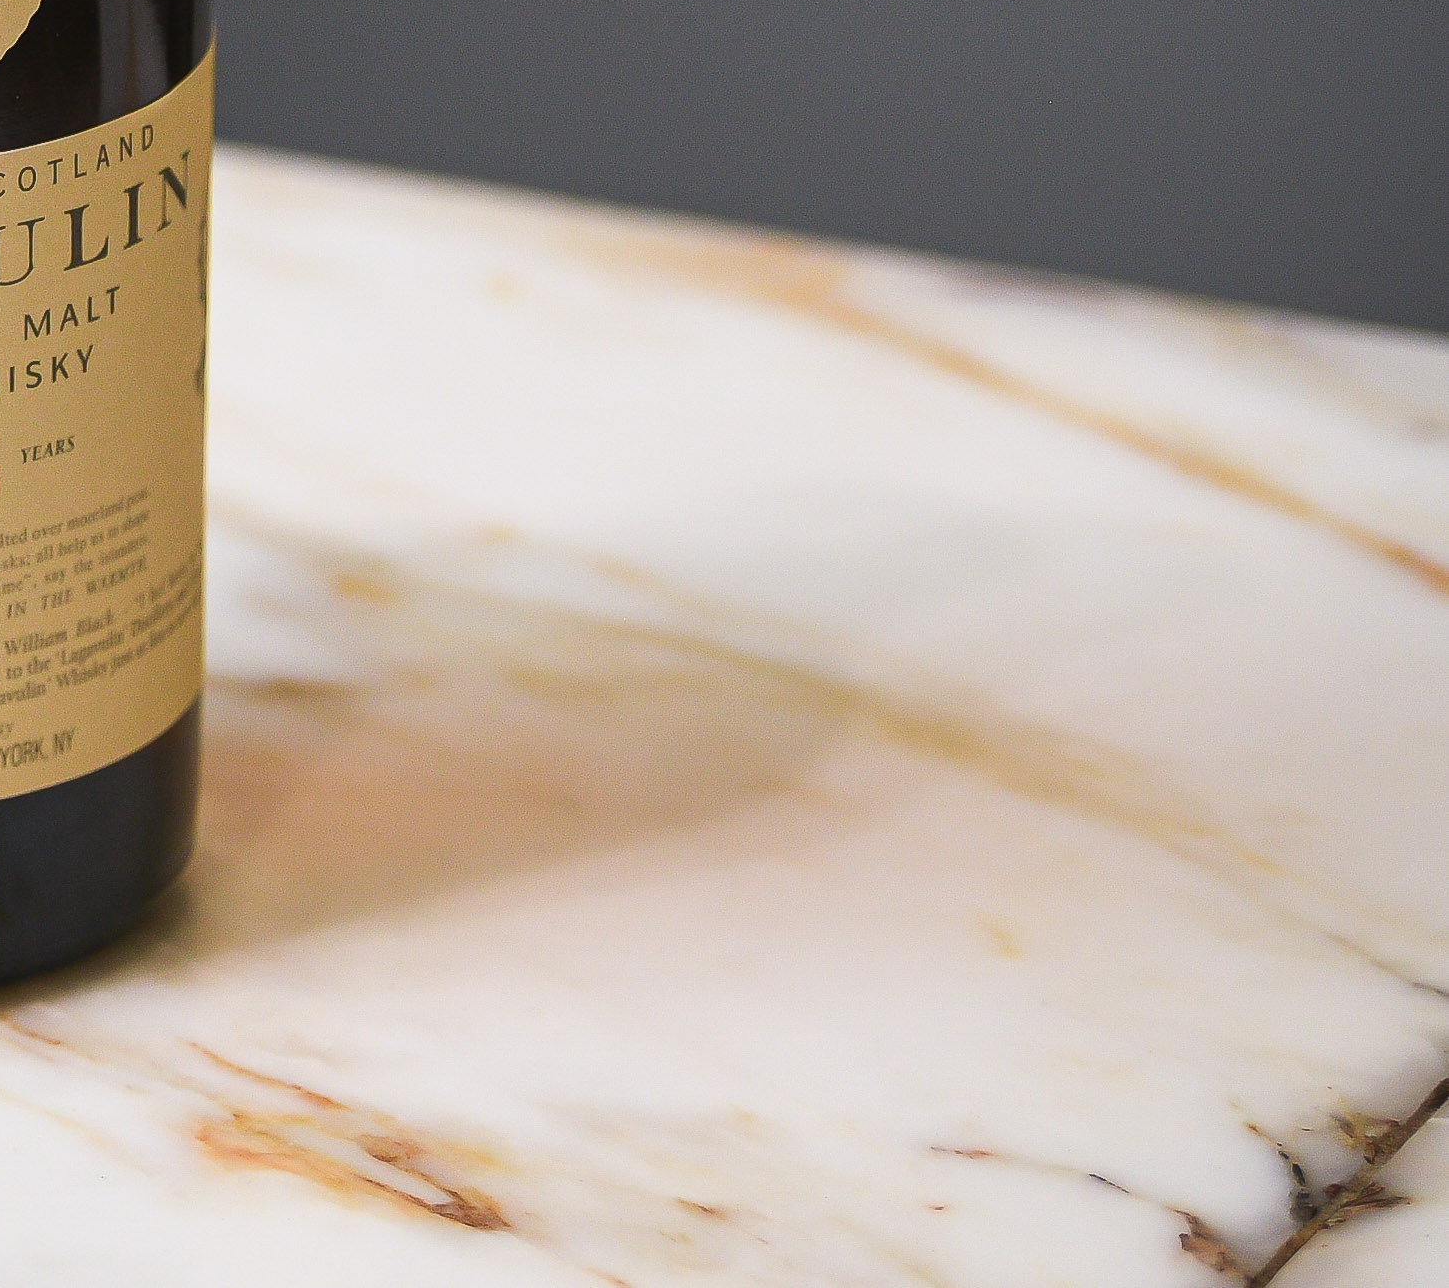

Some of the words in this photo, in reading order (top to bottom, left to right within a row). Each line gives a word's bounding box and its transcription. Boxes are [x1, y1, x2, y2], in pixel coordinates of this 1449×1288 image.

[24, 286, 121, 342] MALT
[20, 436, 76, 465] YEARS
[7, 600, 28, 620] IN
